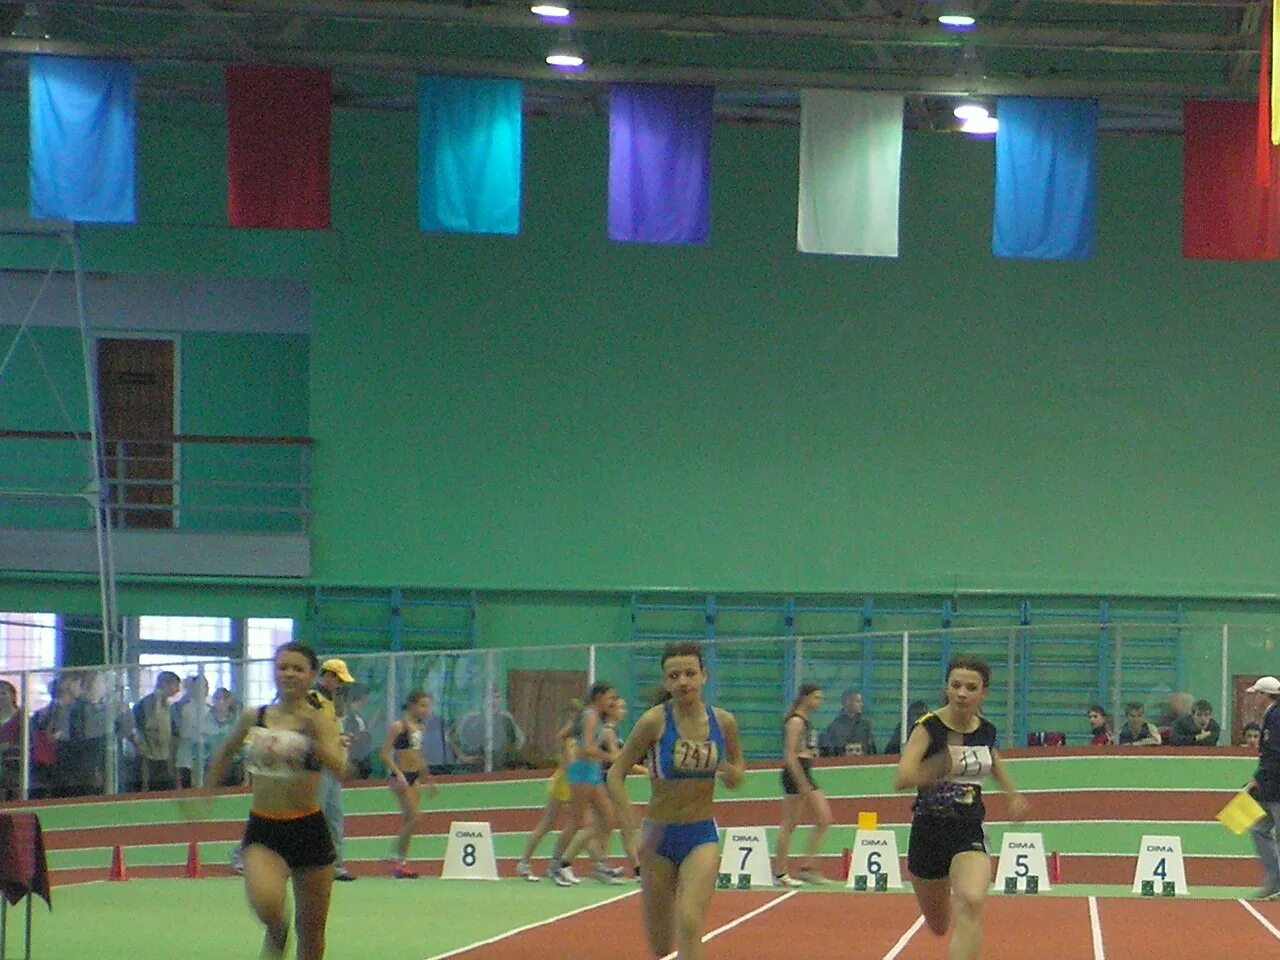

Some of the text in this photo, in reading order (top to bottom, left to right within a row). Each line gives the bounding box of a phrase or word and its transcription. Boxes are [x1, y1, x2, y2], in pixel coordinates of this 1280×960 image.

[680, 741, 713, 769] 247
[456, 830, 483, 838] DIMA
[732, 834, 760, 843] DIMA
[861, 838, 888, 847] DIMA
[1008, 841, 1036, 850] DIMA
[462, 843, 477, 867] 8
[738, 846, 753, 871] 7
[1146, 844, 1175, 853] DIMA
[866, 851, 881, 875] 6
[1014, 854, 1030, 878] 5
[1152, 857, 1168, 881] 4
